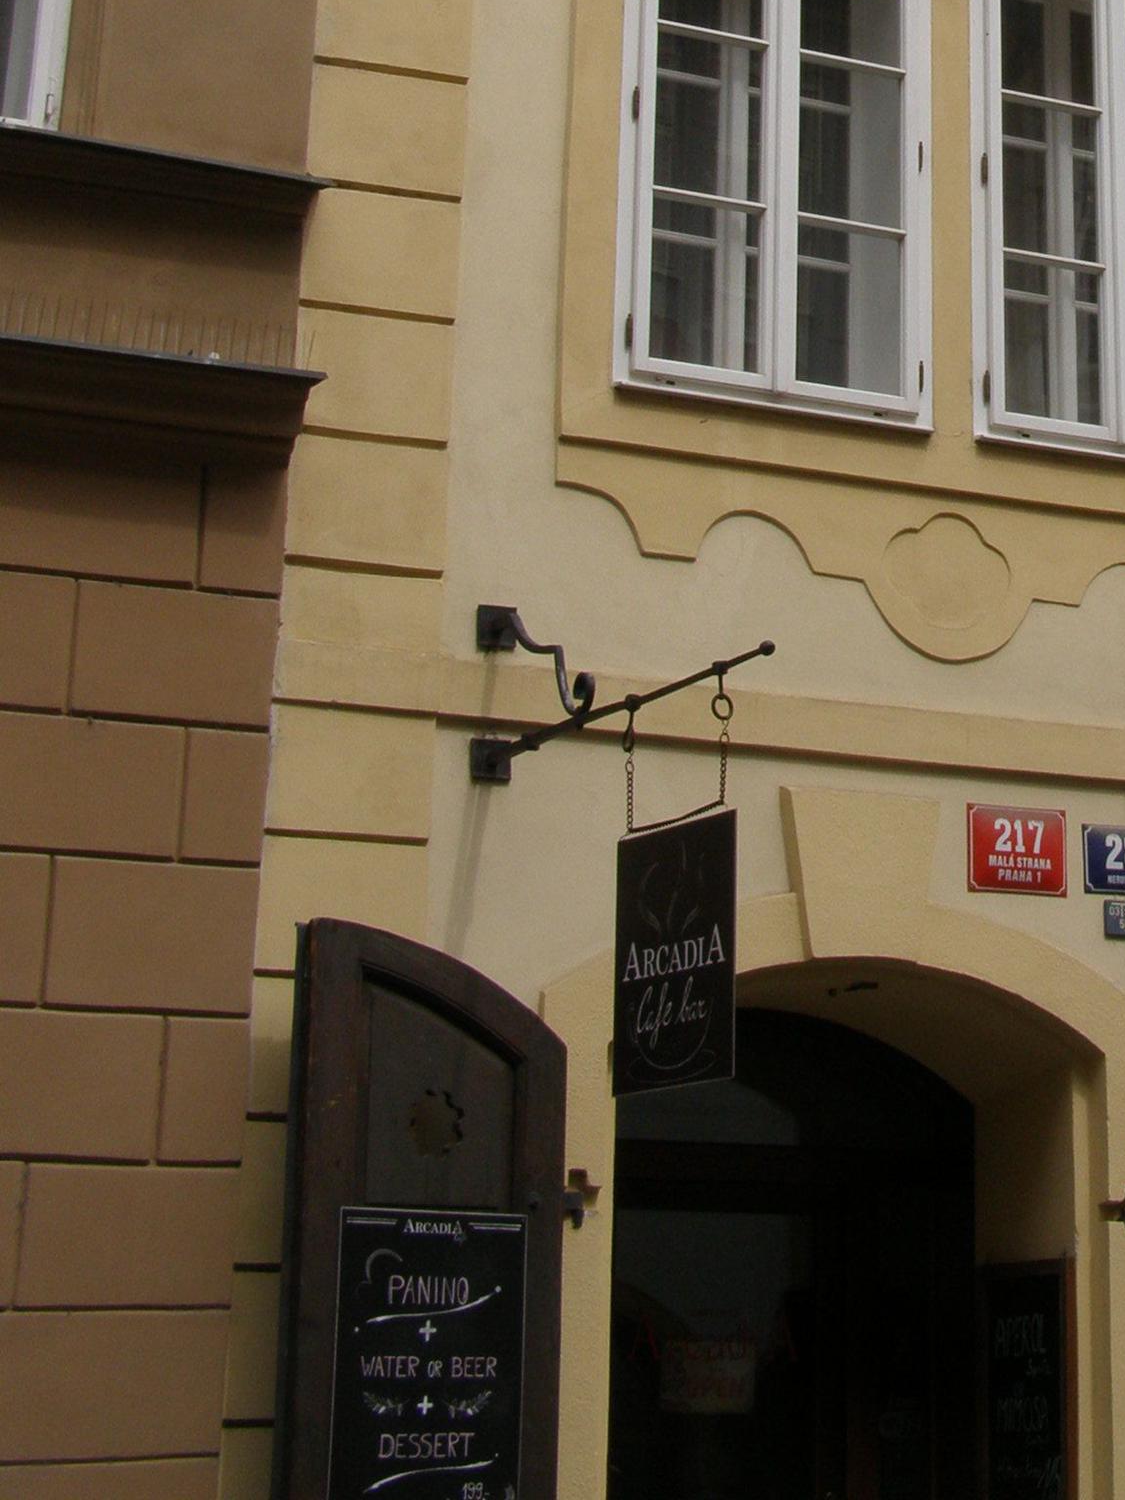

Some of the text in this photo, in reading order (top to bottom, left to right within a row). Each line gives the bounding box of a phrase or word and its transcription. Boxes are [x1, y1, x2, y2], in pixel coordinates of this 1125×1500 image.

[993, 818, 1045, 855] 217
[988, 853, 1052, 870] MALÁ STRANA
[997, 868, 1042, 883] PRAHA 1
[622, 923, 727, 982] ARCADIA
[675, 975, 709, 1025] bar
[403, 1218, 464, 1235] ARCADIA
[388, 1275, 470, 1305] PANINO
[360, 1356, 498, 1378] WATER OR BEER
[378, 1433, 477, 1459] DESSERT
